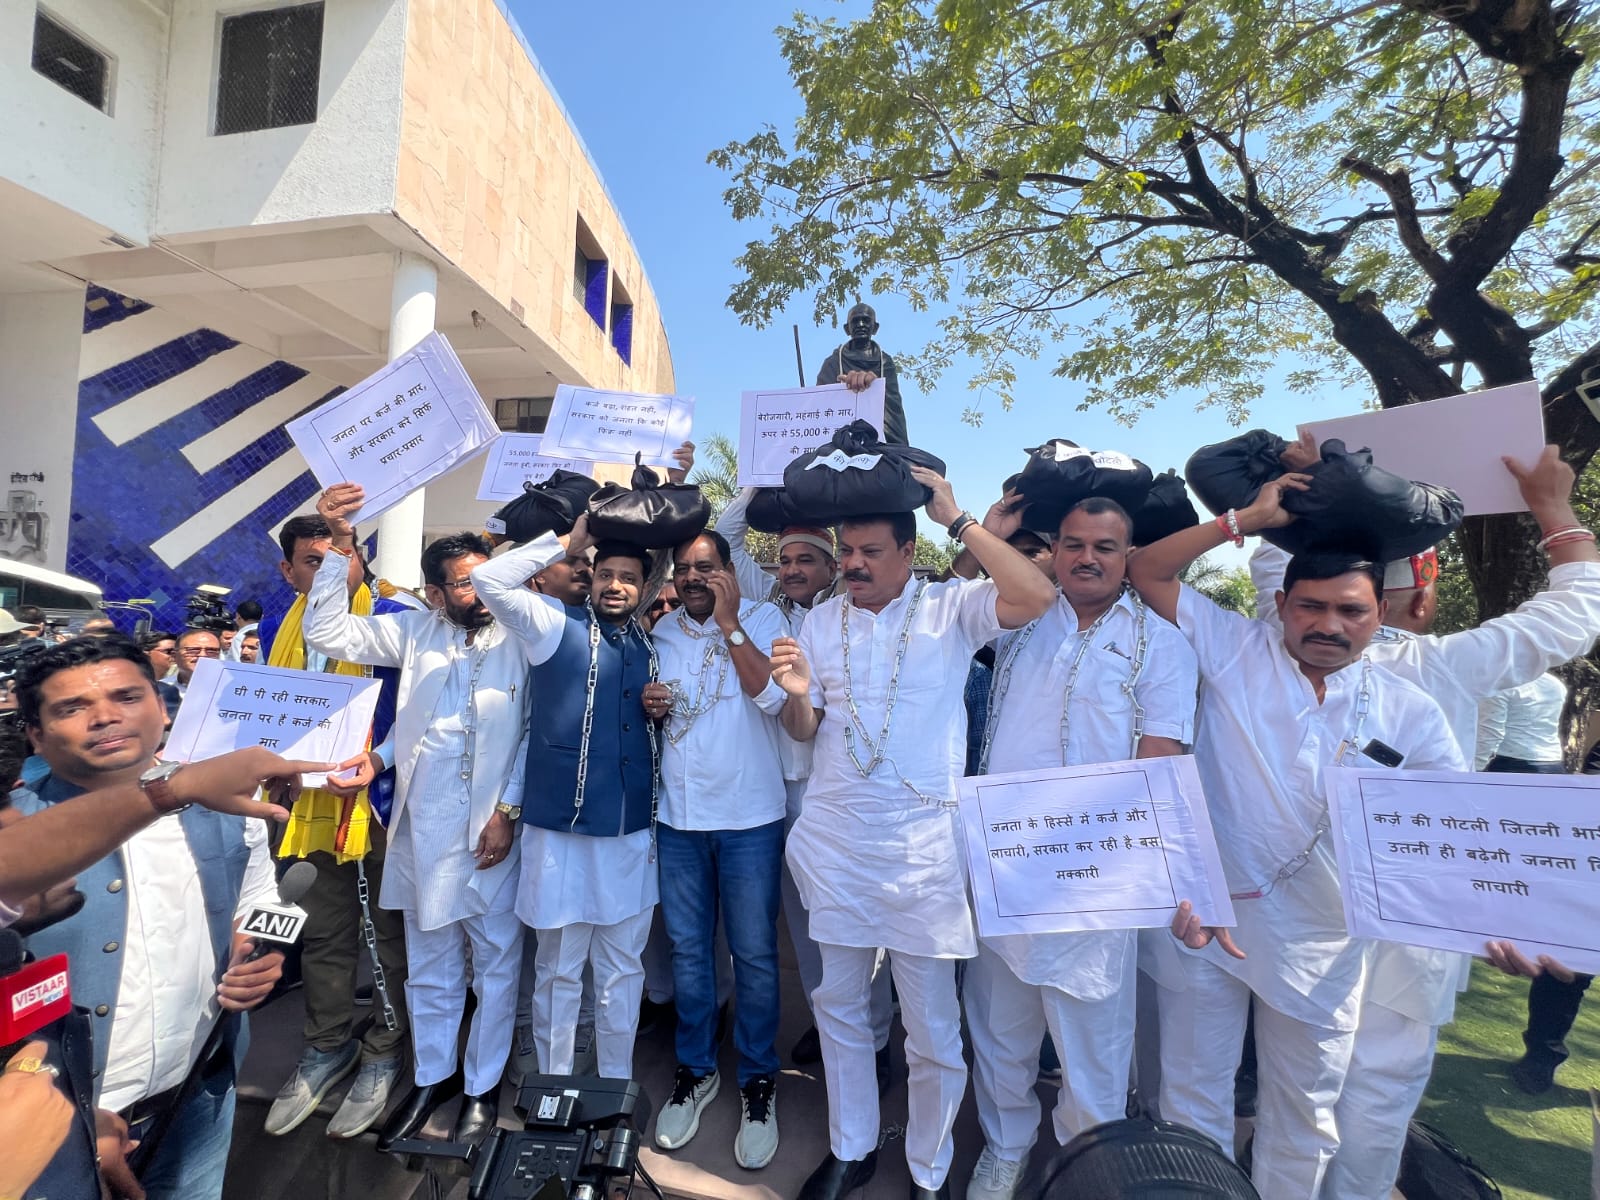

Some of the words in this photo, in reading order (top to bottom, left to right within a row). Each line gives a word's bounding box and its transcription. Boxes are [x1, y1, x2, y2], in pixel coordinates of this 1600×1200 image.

[331, 425, 357, 443] जनता
[360, 416, 372, 426] पर
[375, 402, 391, 418] कर्ज
[394, 395, 406, 406] की
[408, 383, 427, 397] मार,
[824, 408, 834, 418] की
[838, 408, 854, 417] मार,
[348, 445, 365, 460] और
[367, 426, 396, 448] सरकार
[761, 429, 777, 439] ऊपर
[780, 428, 788, 438] से
[790, 428, 821, 439] 55,000
[380, 434, 424, 465] प्रचार-प्रसार
[234, 685, 248, 697] घी
[254, 688, 266, 700] पी
[271, 690, 288, 703] रही
[293, 694, 331, 709] सरकार,
[218, 709, 253, 721] जनता
[258, 713, 273, 724] पर
[292, 716, 313, 728] कर्ज
[317, 718, 332, 730] की
[259, 737, 280, 748] मार
[990, 820, 1022, 833] जनता
[1028, 817, 1038, 830] के
[1044, 814, 1073, 830] हिस्से
[1079, 811, 1092, 826] में
[1096, 809, 1119, 824] कर्ज
[1125, 807, 1148, 822] और
[1372, 811, 1402, 827] कर्ज़
[1410, 813, 1431, 828] की
[1440, 815, 1490, 833] पोटली
[1499, 818, 1560, 838] जितनी
[989, 843, 1030, 859] लाचारी,
[1033, 843, 1070, 857] सरकार
[1075, 841, 1093, 852] कर
[1099, 836, 1118, 852] रही
[1123, 835, 1133, 850] है
[1139, 836, 1160, 848] बस
[1387, 841, 1430, 856] उतनी
[1438, 843, 1456, 860] ही
[1464, 847, 1511, 864] बढ़ेगी
[1521, 854, 1576, 870] जनता
[1055, 864, 1100, 881] मक्कारी
[1470, 878, 1529, 897] लाचारी
[248, 912, 297, 937] ANI
[15, 975, 65, 1007] VISTAAR
